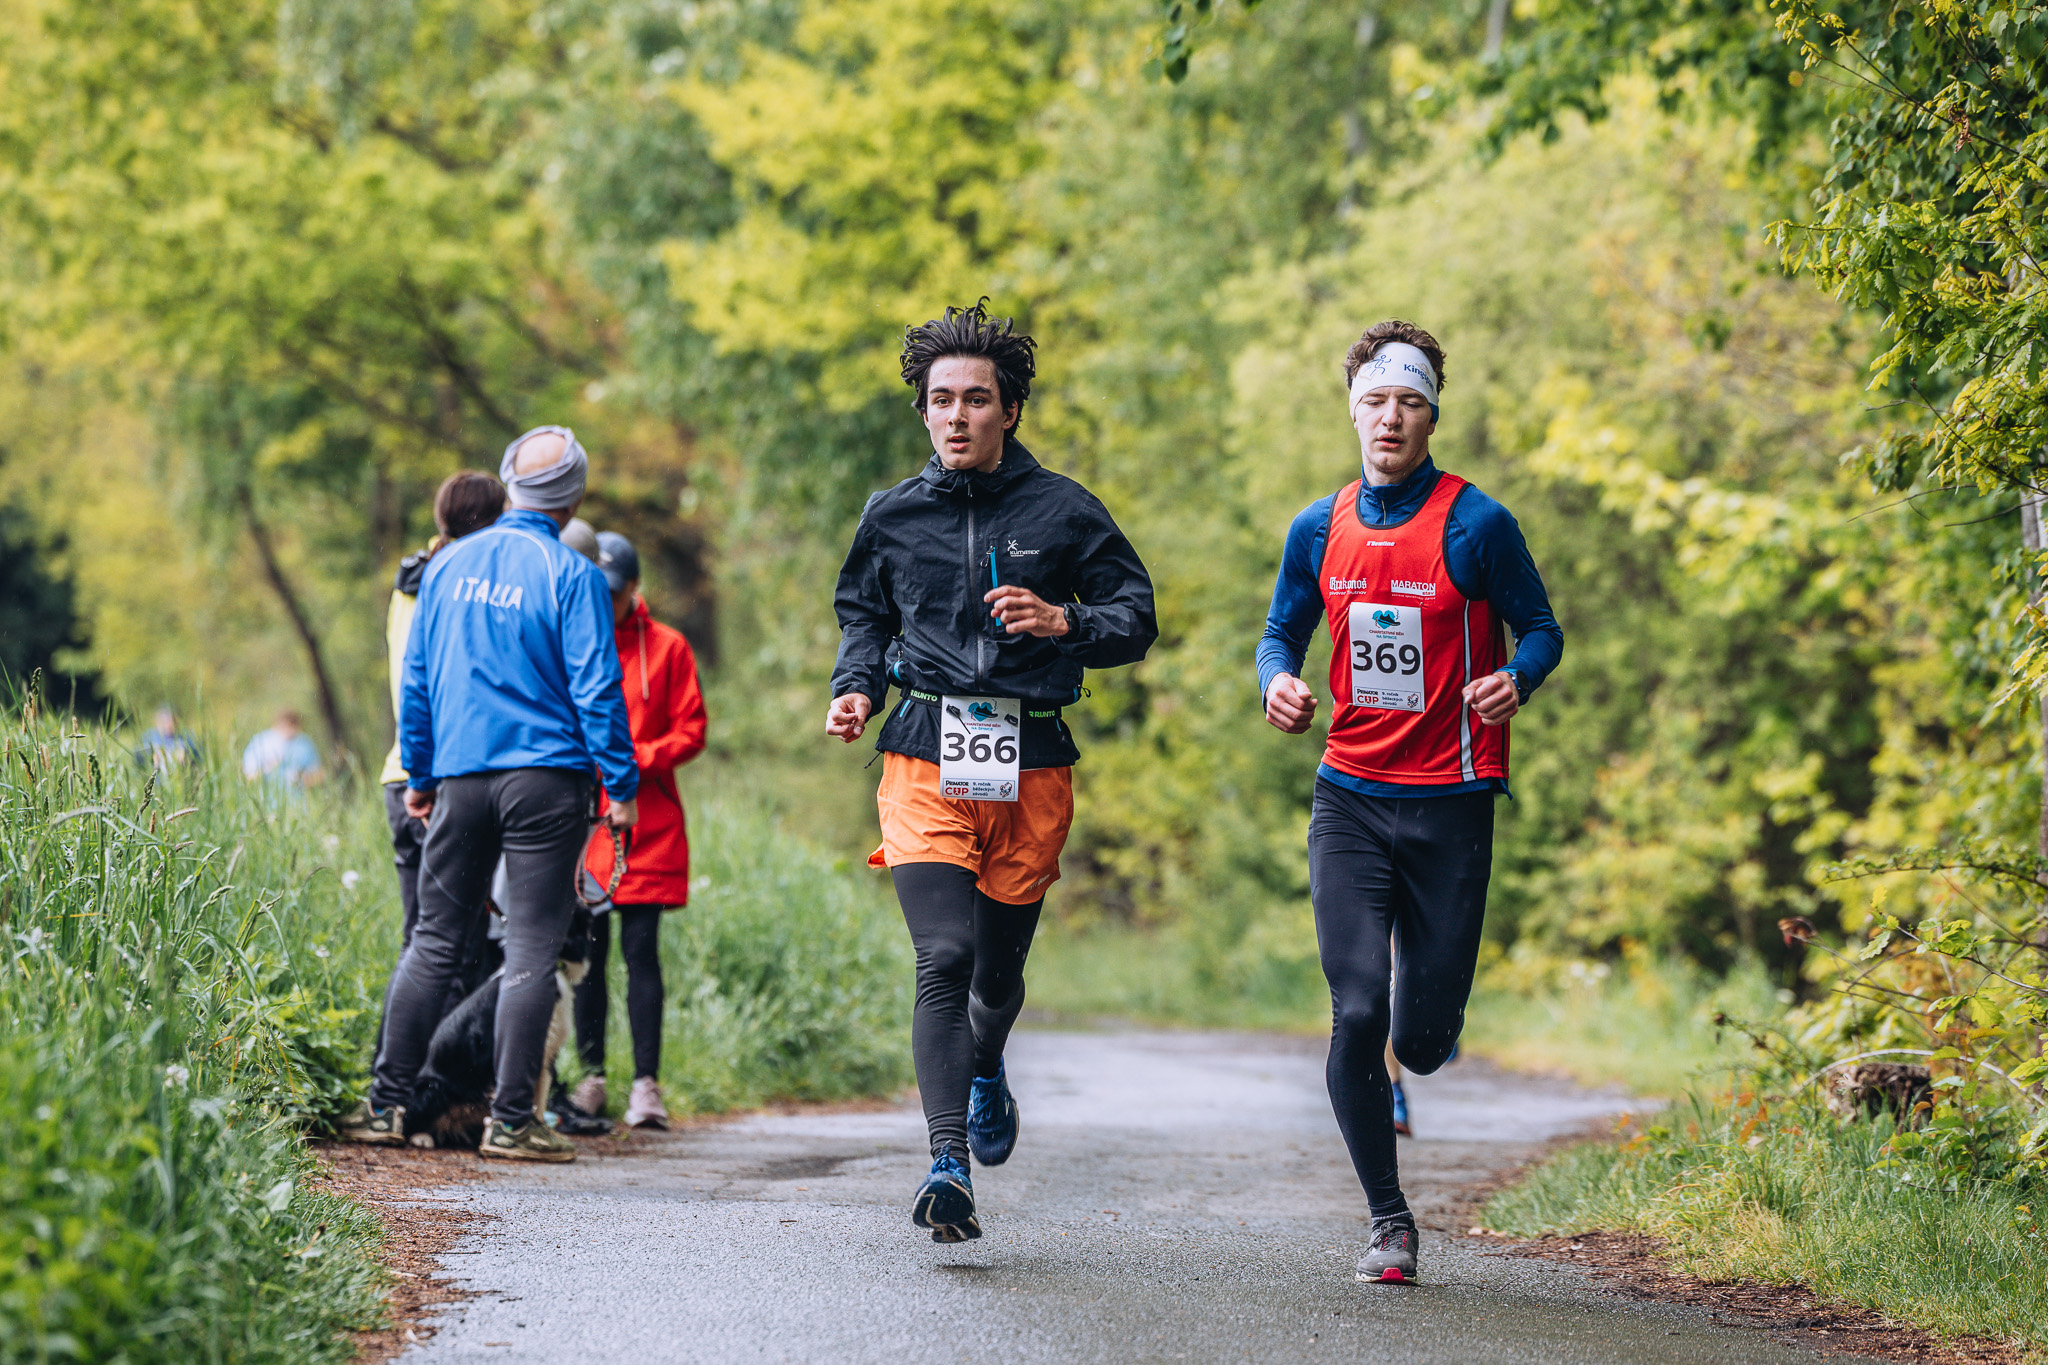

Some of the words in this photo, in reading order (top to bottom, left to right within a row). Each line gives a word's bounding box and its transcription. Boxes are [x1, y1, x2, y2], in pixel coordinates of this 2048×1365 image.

[1391, 579, 1435, 591] MARATON
[453, 576, 523, 611] ITALIA
[1351, 640, 1421, 676] 369
[1357, 695, 1379, 704] CUP
[1034, 710, 1055, 718] RUNTO
[943, 732, 1017, 765] 366
[945, 787, 969, 796] CUP
